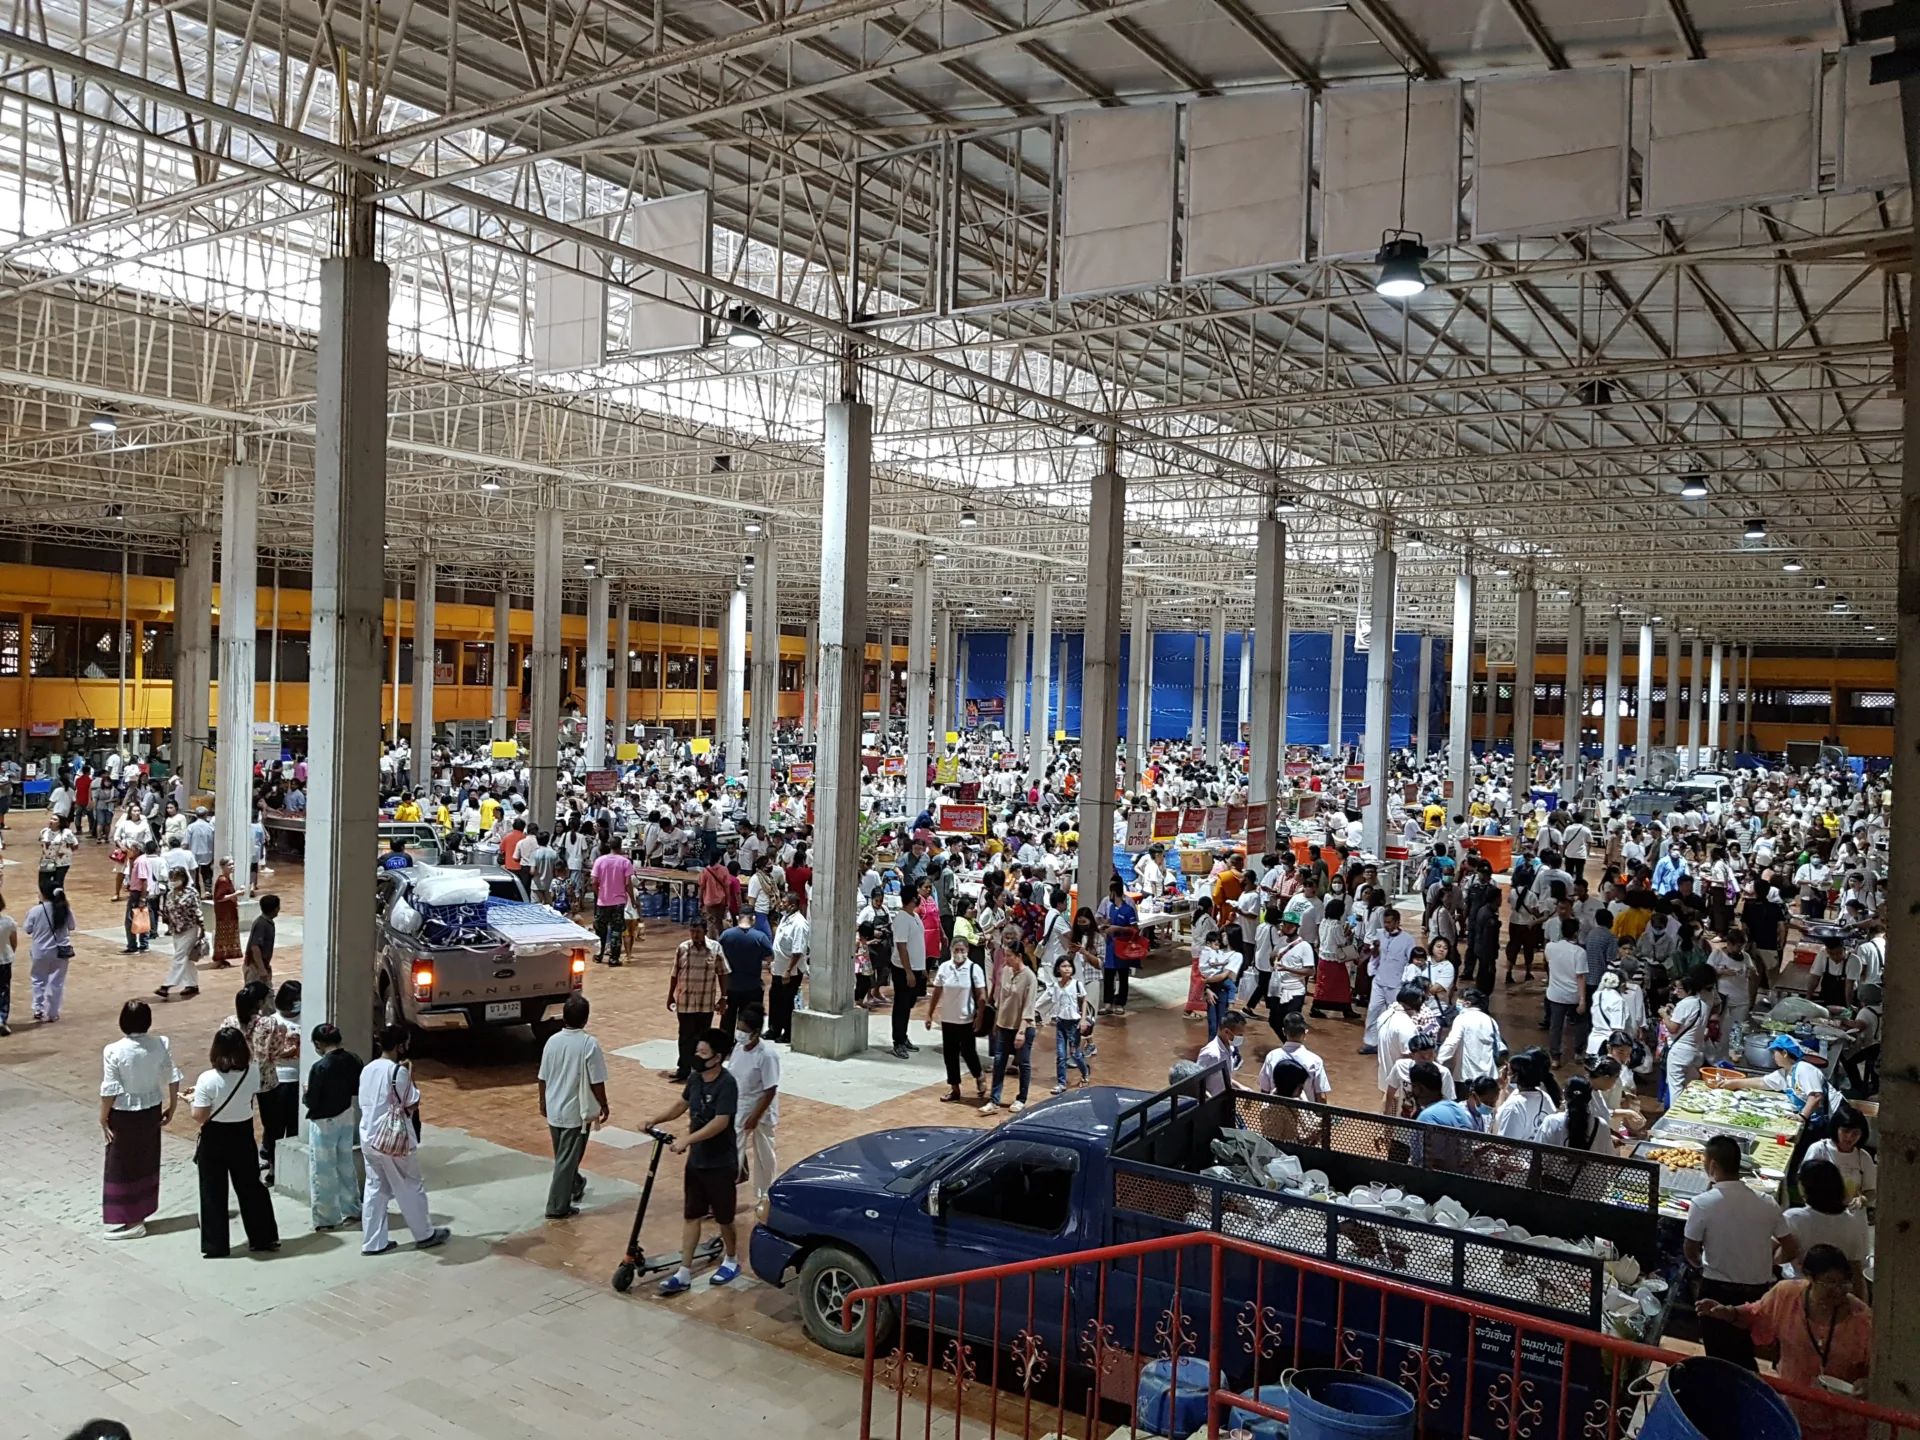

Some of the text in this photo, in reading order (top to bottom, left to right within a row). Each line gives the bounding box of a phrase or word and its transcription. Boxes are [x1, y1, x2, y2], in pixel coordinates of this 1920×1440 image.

[438, 981, 567, 997] RANGER
[1469, 1327, 1512, 1342] ระวิเชียร
[1510, 1349, 1546, 1363] กุภาพันธ์
